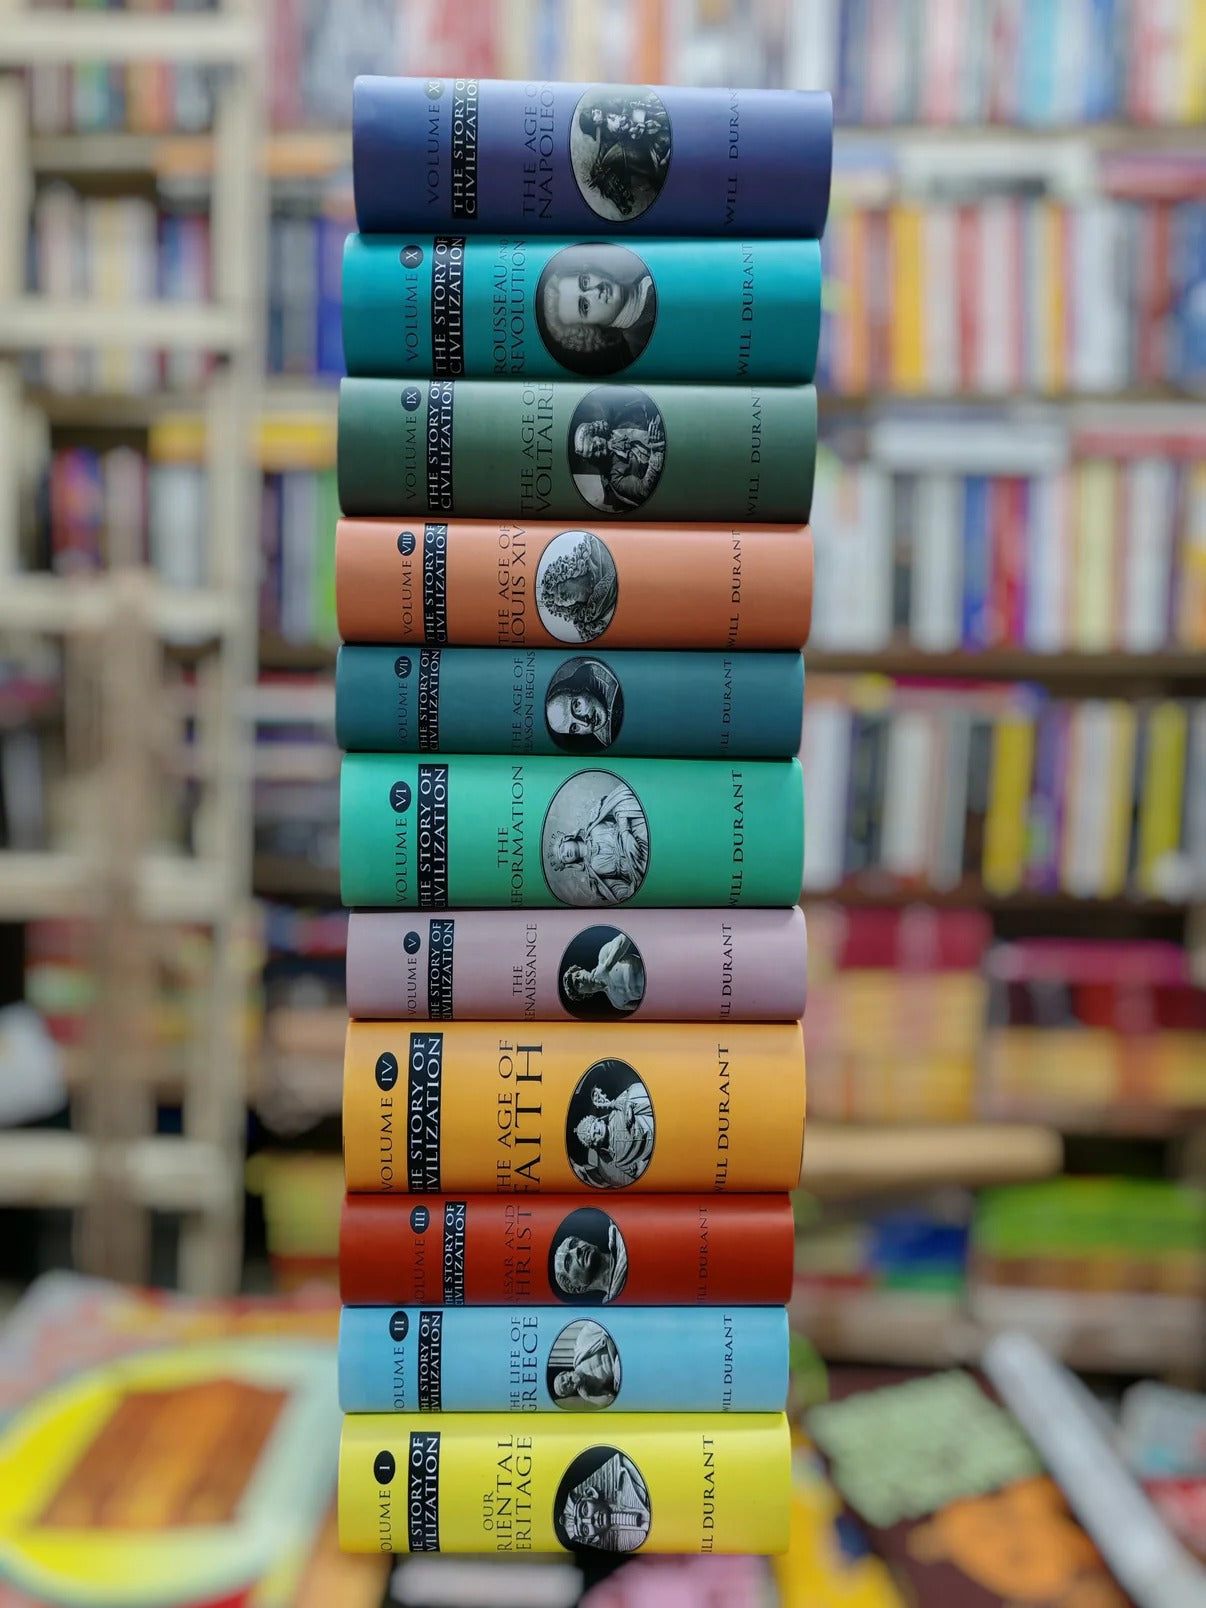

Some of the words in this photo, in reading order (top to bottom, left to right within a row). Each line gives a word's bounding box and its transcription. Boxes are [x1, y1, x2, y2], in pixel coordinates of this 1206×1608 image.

[455, 79, 465, 91] O
[454, 96, 465, 158] STORY
[524, 106, 537, 152] AGE
[728, 87, 739, 159] DURAN
[427, 104, 440, 204] VOLUME
[454, 168, 464, 213] THE
[523, 162, 537, 217] THE
[724, 175, 738, 225] WILL
[405, 251, 418, 260] X
[436, 237, 448, 255] OF
[498, 238, 509, 260] AND
[434, 261, 446, 325] STORY
[741, 243, 754, 321] DURANT
[405, 274, 418, 362] VOLUME
[449, 237, 463, 374] CIVILIZATION
[493, 264, 508, 374] ROUSSEAU
[511, 240, 526, 373] REVOLUTION
[435, 334, 447, 371] THE
[737, 329, 751, 377] WILL
[406, 392, 417, 404] IX
[430, 381, 440, 400] OF
[429, 405, 439, 464] STORY
[441, 381, 452, 509] CIVILIZATION
[522, 414, 535, 459] AGE
[537, 383, 553, 511] VOLTAIRE
[405, 416, 417, 500] VOLUME
[429, 472, 439, 508] THE
[521, 468, 534, 513] THE
[746, 473, 760, 516] WILL
[402, 534, 412, 554] VIII
[425, 525, 435, 544] OF
[512, 525, 526, 566] XIV
[424, 549, 434, 606] STORY
[436, 525, 446, 642] CIVILIZATION
[498, 558, 510, 600] AGE
[731, 529, 742, 603] DURANT
[402, 560, 413, 635] VOLUME
[512, 576, 526, 644] LOUIS
[426, 612, 435, 640] THE
[498, 609, 509, 646] THE
[728, 613, 739, 649] WILL
[399, 659, 408, 676] VII
[420, 650, 430, 667] OF
[513, 657, 524, 678] OF
[525, 651, 536, 699] BEGINS
[419, 672, 429, 721] STORY
[430, 650, 439, 750] CIVILIZATION
[513, 684, 523, 716] AGE
[722, 659, 732, 724] DURANT
[420, 726, 428, 749] THE
[395, 789, 407, 807] VI
[420, 768, 431, 795] OF
[420, 801, 431, 872] STORY
[732, 769, 744, 863] DURANT
[395, 818, 407, 903] VOLUME
[497, 827, 509, 869] THE
[408, 938, 417, 948] V
[431, 922, 441, 942] OF
[430, 947, 440, 996] STORY
[513, 965, 523, 997] THE
[721, 923, 732, 997] DURANT
[407, 958, 417, 1015] VOLUME
[719, 1001, 731, 1018] ILL
[381, 1060, 393, 1082] IV
[412, 1038, 425, 1071] OF
[498, 1040, 513, 1079] OF
[426, 1038, 440, 1192] IVILIZATION
[718, 1044, 730, 1150] DURANT
[411, 1081, 424, 1160] STORY
[498, 1093, 512, 1148] AGE
[411, 1168, 423, 1192] HE
[415, 1211, 425, 1227] III
[445, 1204, 455, 1226] OF
[504, 1204, 515, 1249] AND
[444, 1231, 454, 1283] STORY
[699, 1207, 708, 1278] DURANT
[394, 1320, 405, 1331] II
[421, 1315, 430, 1337] OF
[511, 1316, 521, 1342] OF
[420, 1342, 429, 1391] STORY
[510, 1350, 520, 1384] LIFE
[723, 1314, 733, 1384] DURANT
[393, 1347, 405, 1410] OLUME
[510, 1391, 520, 1410] HE
[412, 1437, 424, 1467] OF
[411, 1474, 423, 1536] STORY
[425, 1437, 438, 1551] VILIZATION
[497, 1435, 513, 1551] RIENTAL
[516, 1437, 532, 1550] ERITAGE
[702, 1435, 715, 1529] DURANT
[378, 1490, 392, 1552] OLUME
[483, 1491, 494, 1531] OUR
[701, 1535, 714, 1553] ILL
